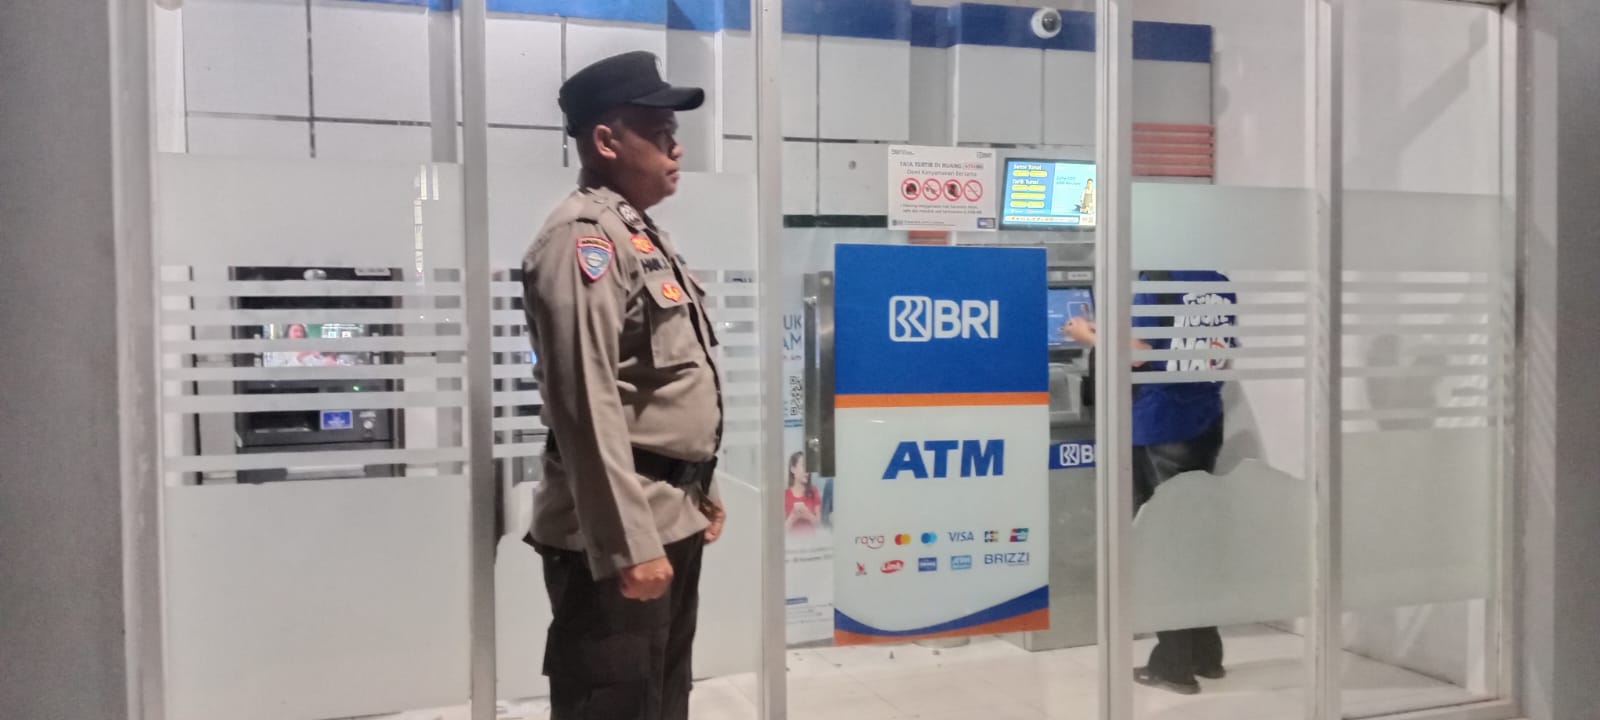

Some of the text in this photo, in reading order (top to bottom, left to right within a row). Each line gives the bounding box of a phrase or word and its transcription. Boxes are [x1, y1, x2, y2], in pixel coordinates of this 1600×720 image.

[934, 300, 999, 339] BRI
[882, 439, 1005, 480] ATM
[948, 531, 975, 541] VISA
[984, 552, 1030, 565] BRIZZI
